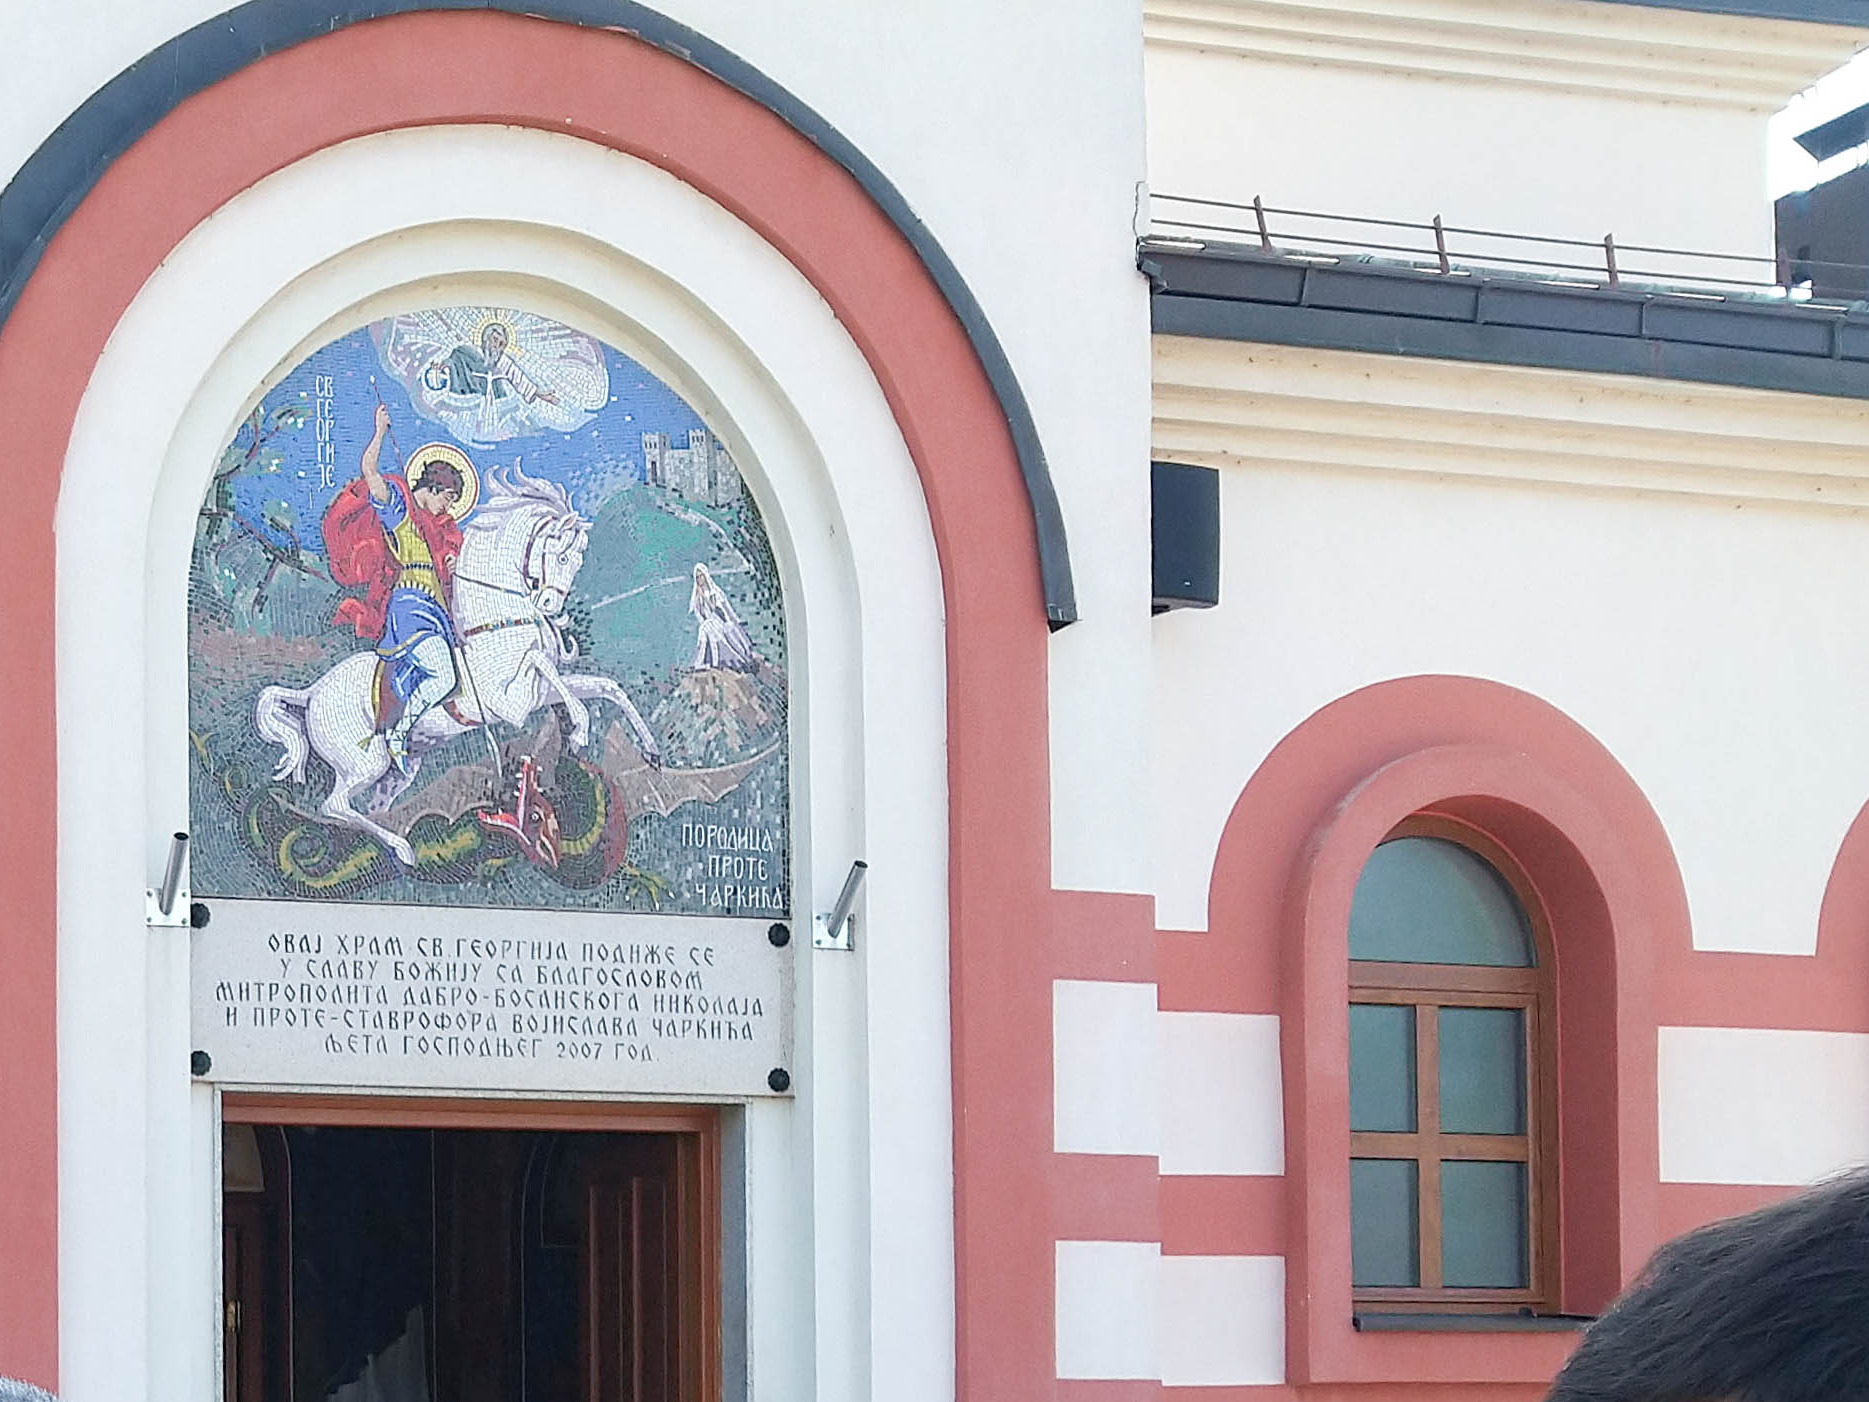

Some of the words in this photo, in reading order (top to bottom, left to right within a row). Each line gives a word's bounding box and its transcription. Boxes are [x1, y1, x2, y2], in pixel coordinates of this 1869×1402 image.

[682, 823, 774, 853] ПОРОДИЦА
[708, 855, 768, 880] ПРОТЕ
[268, 933, 322, 954] ОВАЈ
[337, 934, 403, 956] ХРАМ
[582, 942, 675, 965] ПОДИЖЕ
[689, 947, 714, 966] СЕ
[280, 958, 291, 979] У
[306, 959, 378, 980] СЛАВУ
[394, 961, 482, 982] БОЖИЈУ
[496, 964, 523, 984] СА
[536, 965, 703, 991] БЛАГОСЛОВОМ
[216, 981, 388, 1005] МИТРОПОЛИТА
[653, 993, 763, 1017] НИКОЛАЈА
[226, 1007, 237, 1027] И
[512, 1013, 638, 1037] ВОЈИСЛАВА
[652, 1018, 754, 1041] ЧАРКИЋА
[325, 1034, 388, 1055] ЉЕТА
[403, 1035, 543, 1059] ГОСПОДЊЕГ
[556, 1042, 603, 1059] 2007
